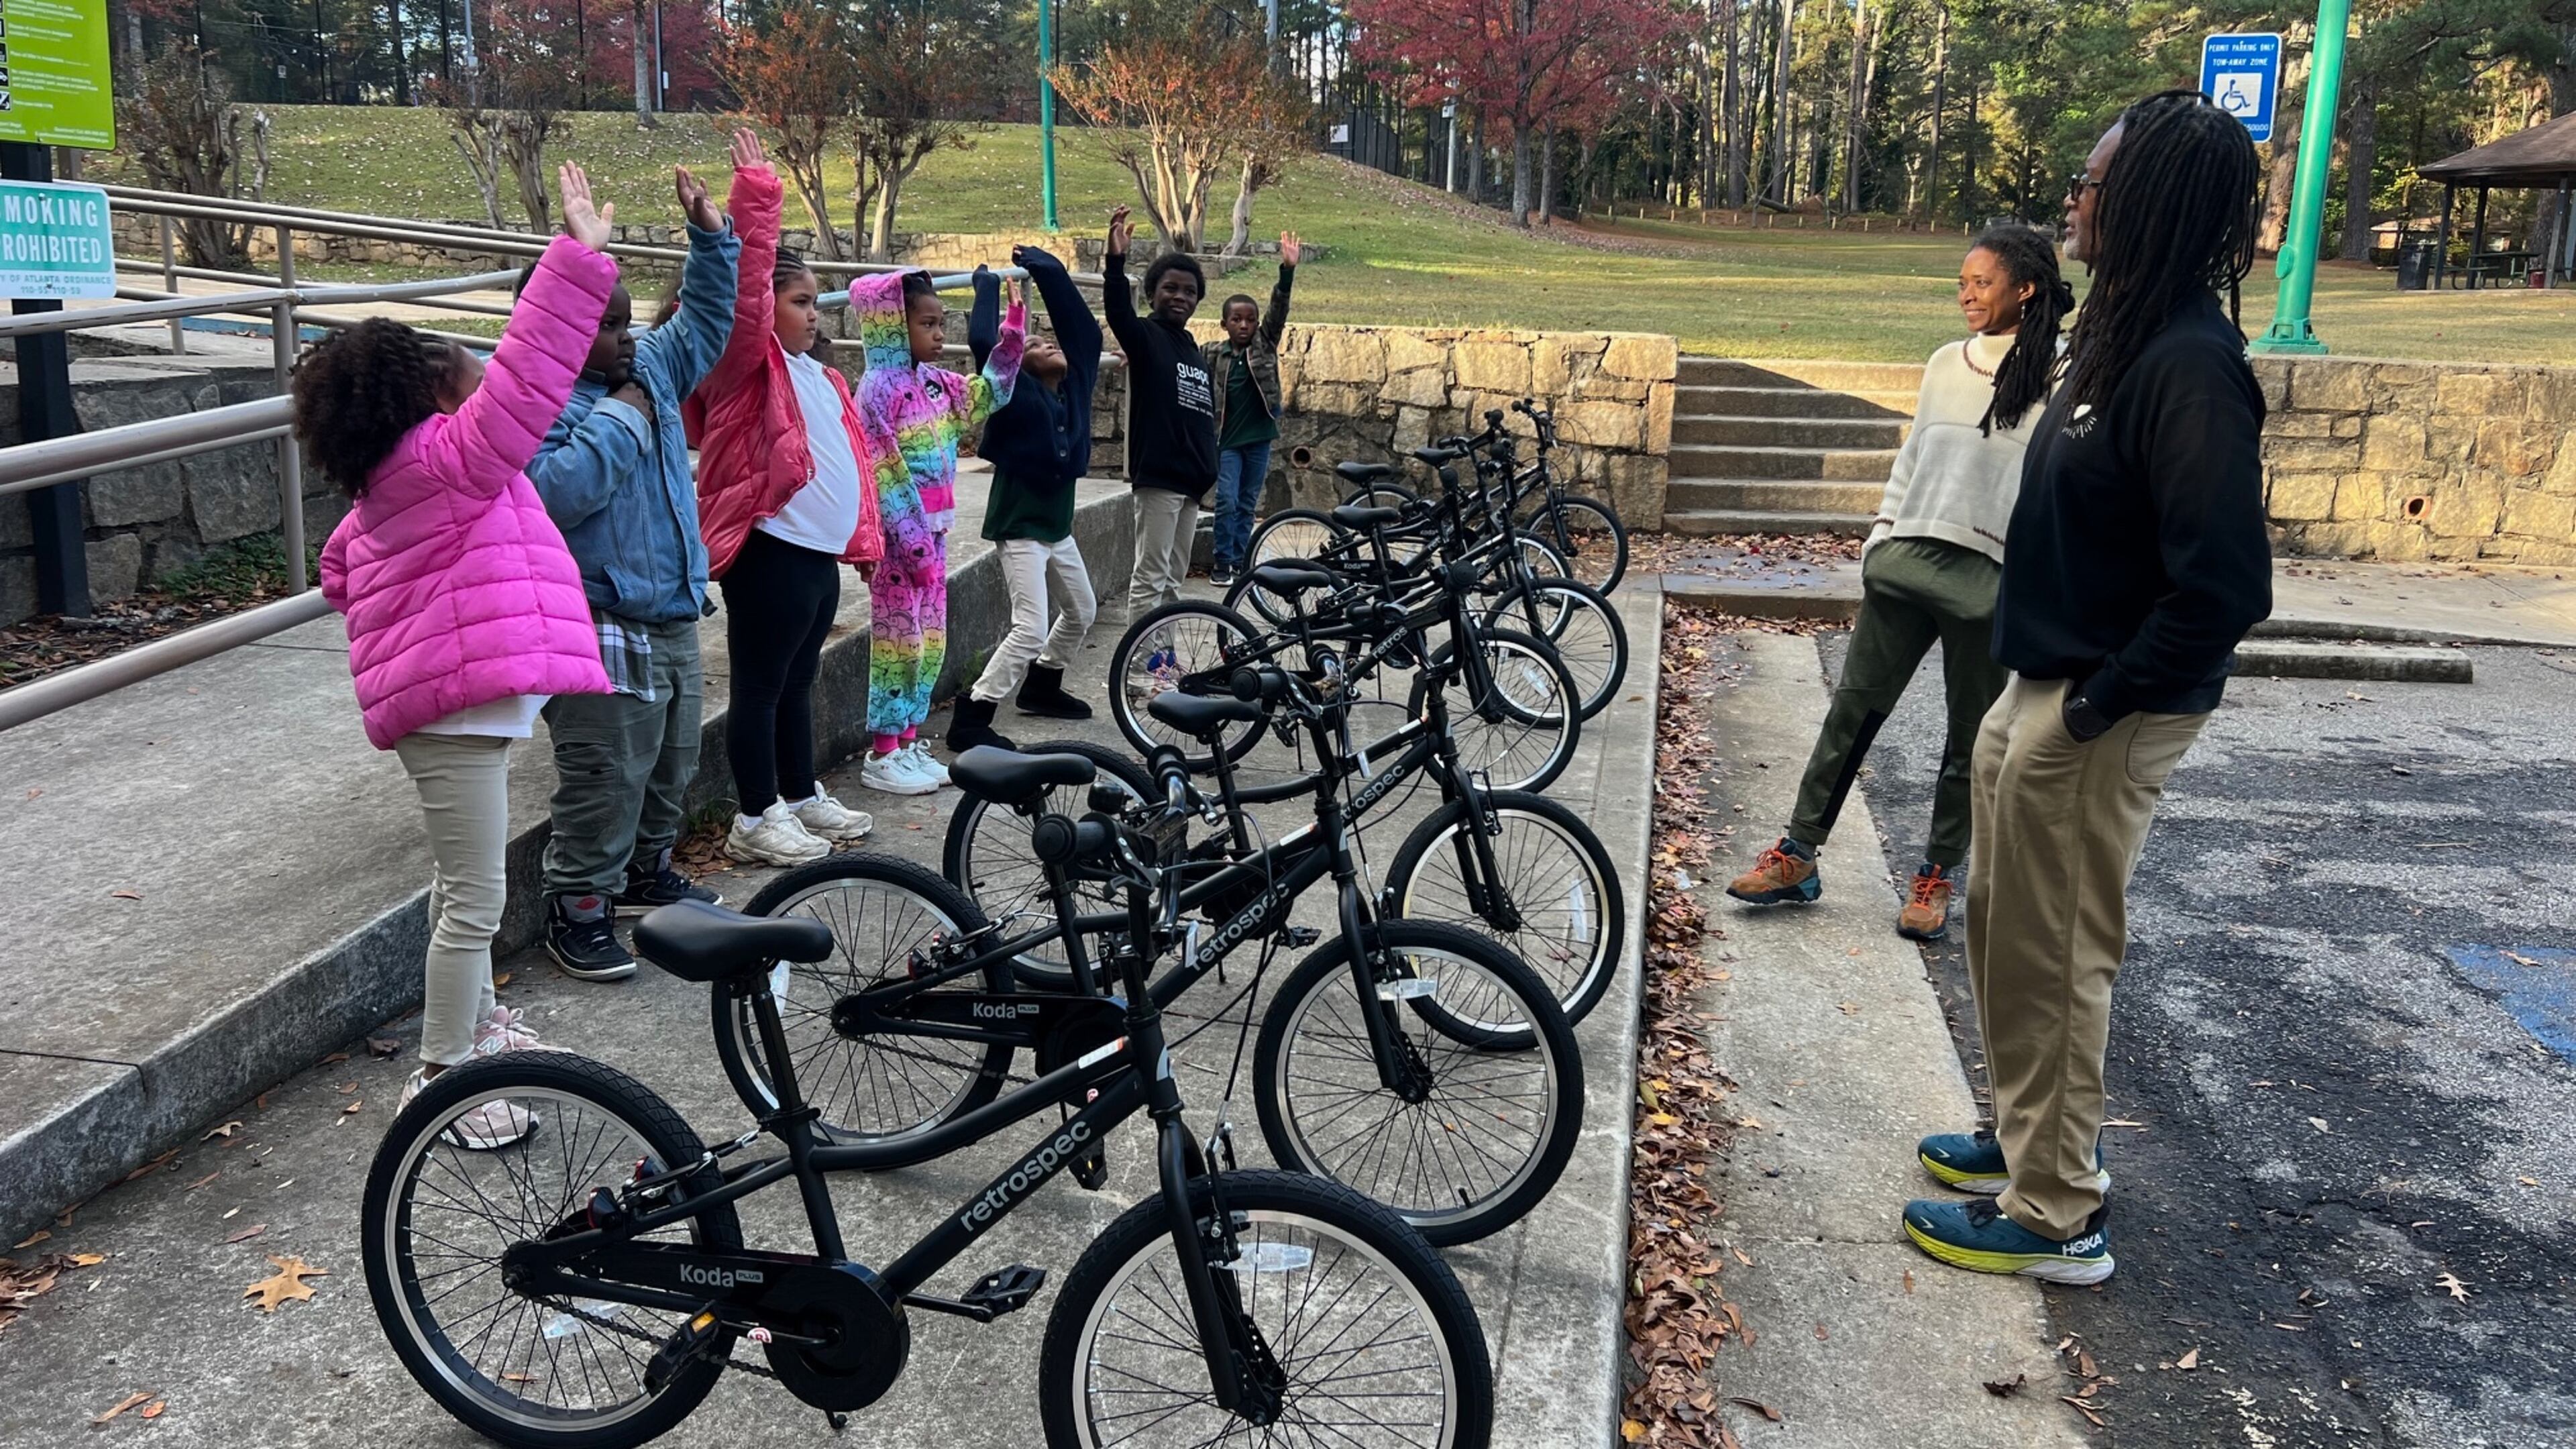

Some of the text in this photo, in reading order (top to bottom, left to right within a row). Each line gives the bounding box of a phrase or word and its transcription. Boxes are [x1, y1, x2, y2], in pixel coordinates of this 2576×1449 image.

[2232, 44, 2257, 52] PARKING
[2260, 44, 2275, 52] ONLY
[2213, 58, 2268, 66] TOW-AWAY ZONE
[4, 195, 99, 227] MOKING
[2, 233, 102, 264] ROHIBITED
[9, 274, 20, 282] OF
[24, 274, 60, 284] ATLANTA
[64, 275, 111, 284] ORDINANCE
[1373, 627, 1408, 659] retros
[1340, 765, 1405, 820] tospec
[973, 1002, 1016, 1019] Koda
[961, 1120, 1091, 1232] retrospec
[2061, 1233, 2104, 1257] HOKA
[680, 1263, 761, 1287] Koda PLUS
